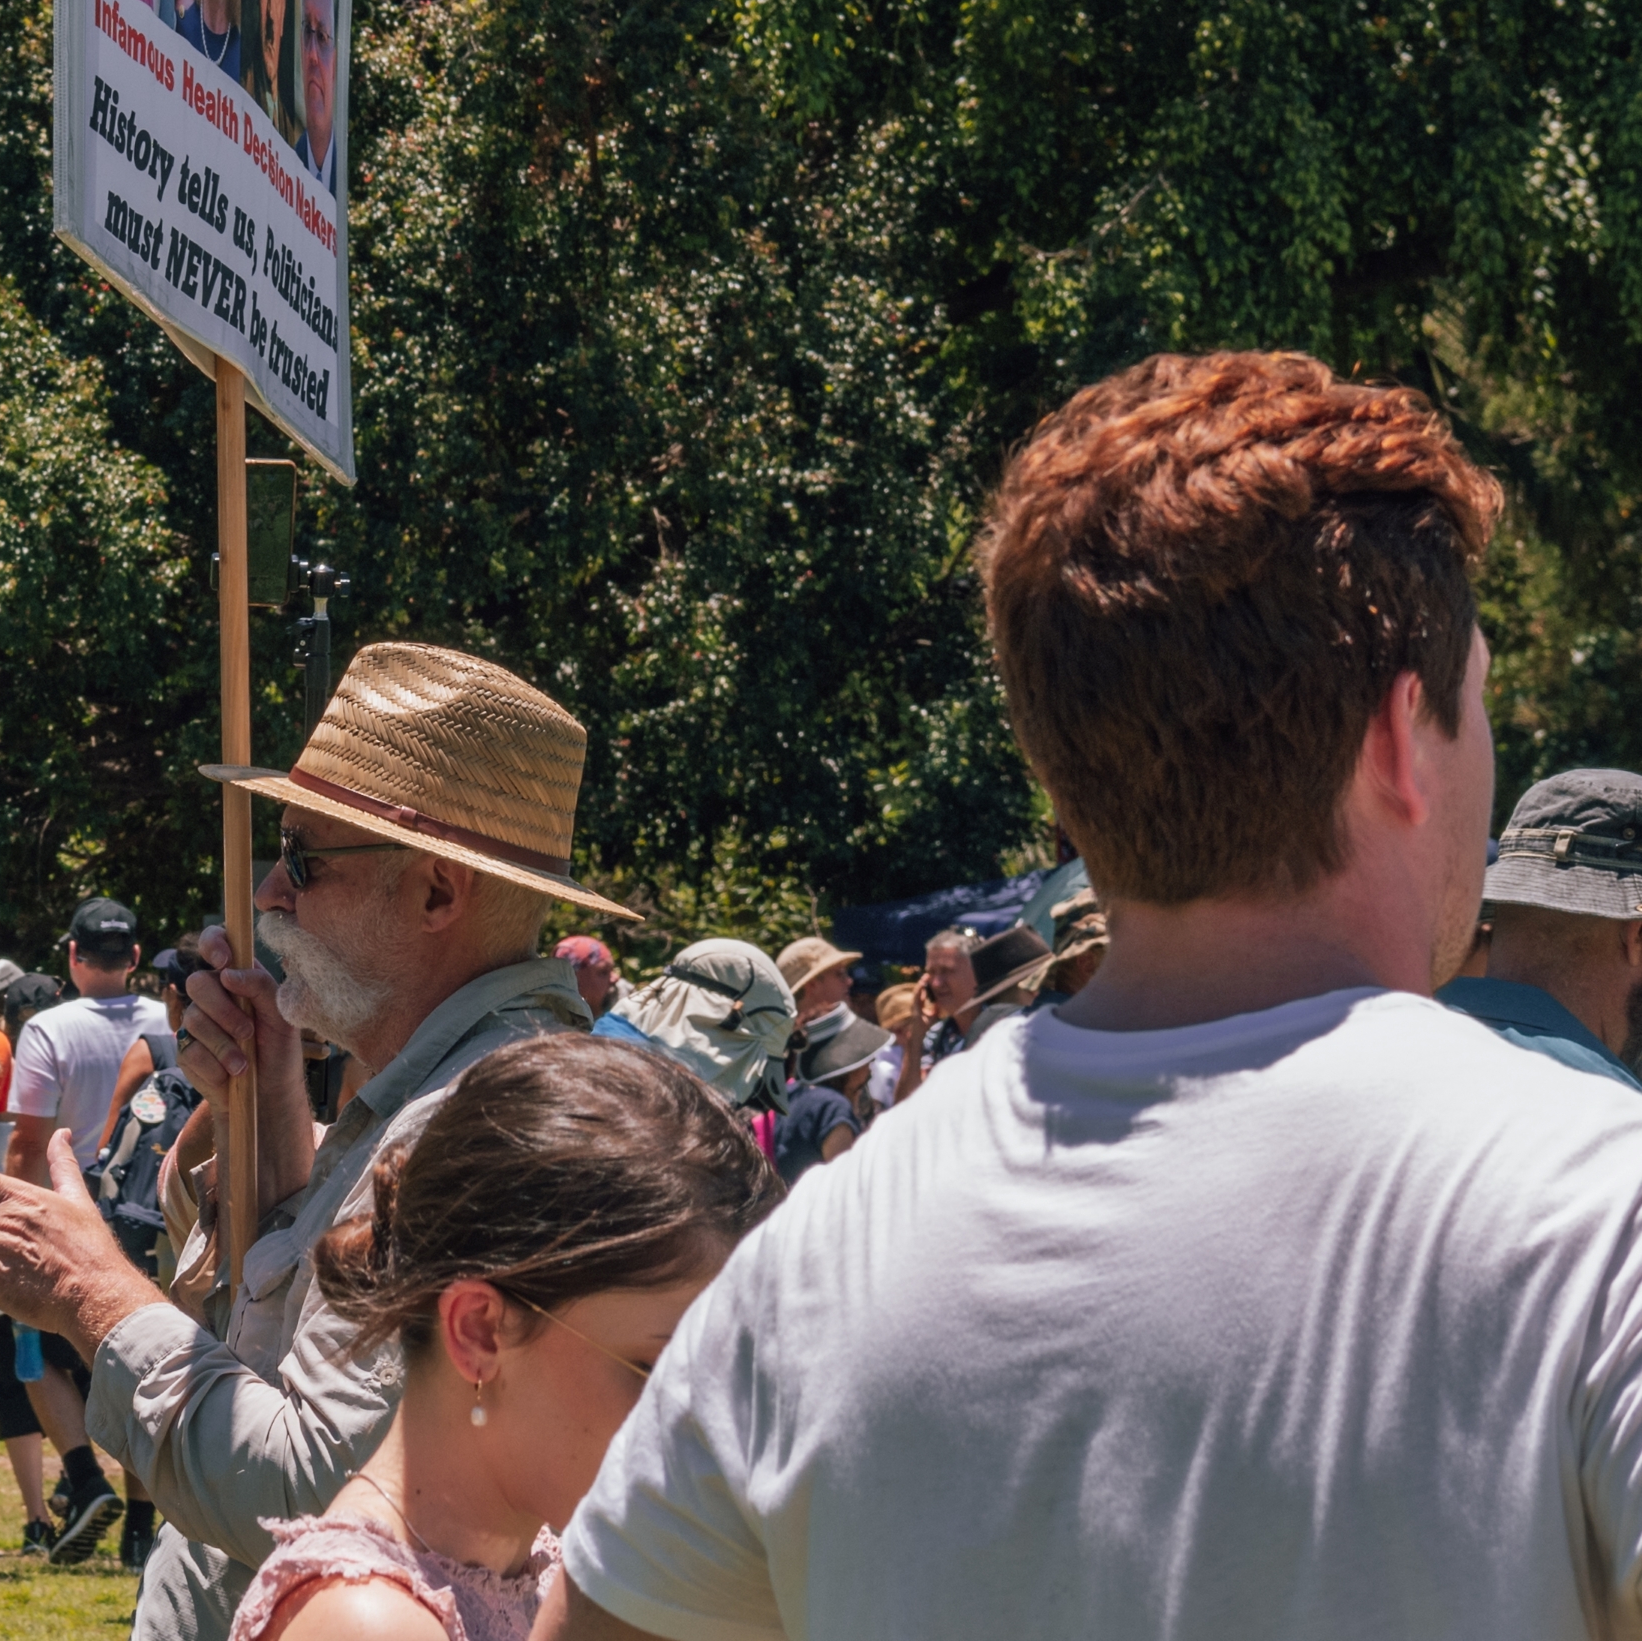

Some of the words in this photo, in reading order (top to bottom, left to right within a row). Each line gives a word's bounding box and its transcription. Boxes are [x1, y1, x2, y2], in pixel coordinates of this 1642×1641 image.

[89, 75, 174, 202] History
[178, 155, 228, 234] tells
[233, 206, 258, 276] us,
[182, 59, 238, 144] Health
[244, 112, 293, 208] Decision
[104, 190, 163, 270] must
[165, 226, 247, 335] NEVER
[250, 290, 267, 357] be
[268, 320, 330, 420] trusted
